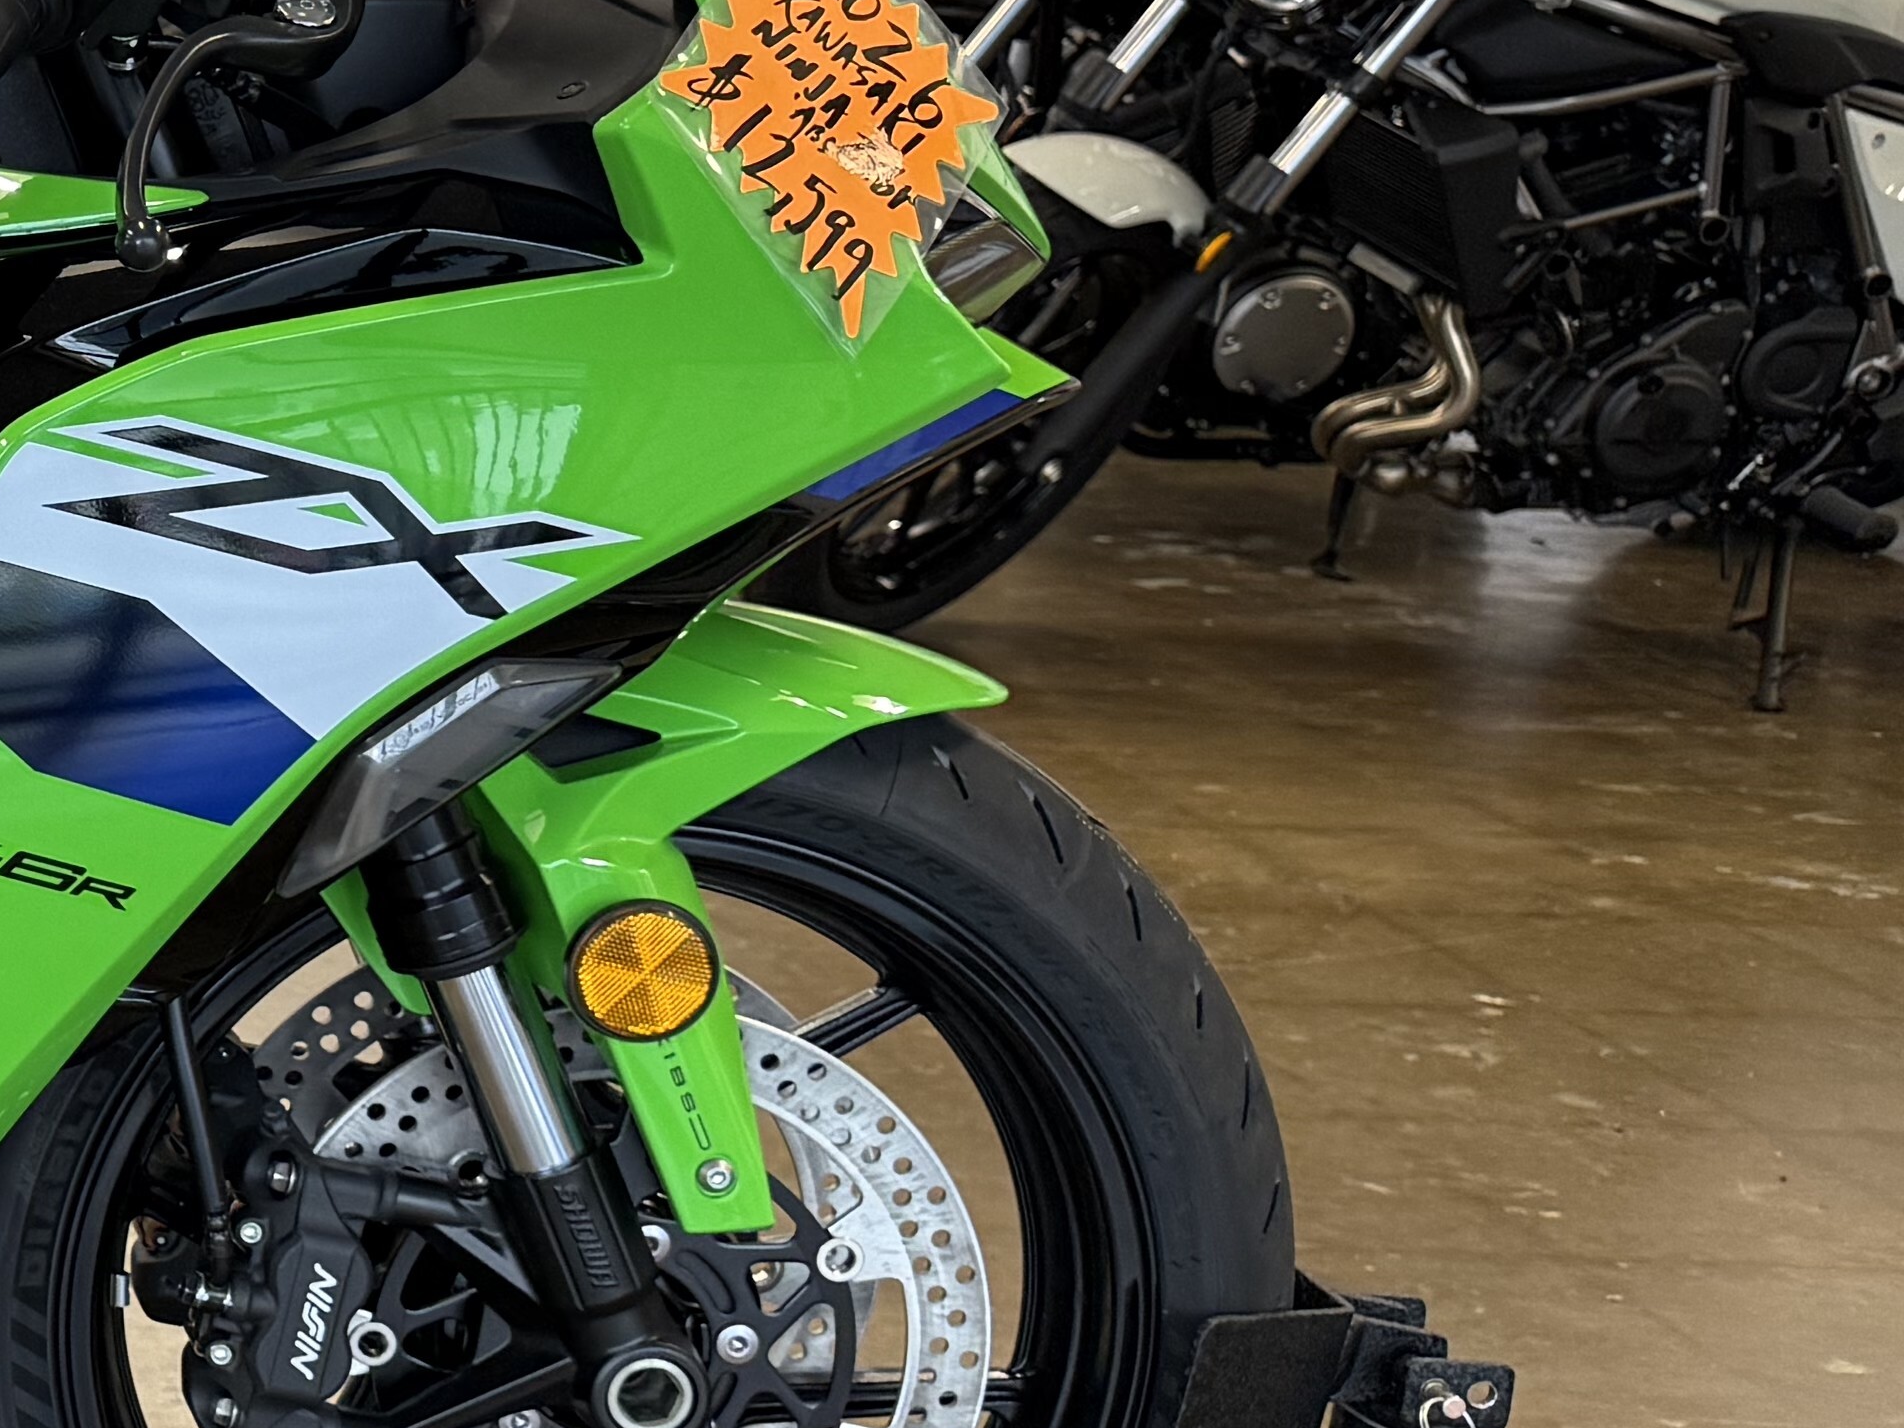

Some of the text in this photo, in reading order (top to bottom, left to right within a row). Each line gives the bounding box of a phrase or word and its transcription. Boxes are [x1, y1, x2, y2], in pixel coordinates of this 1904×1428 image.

[751, 19, 851, 127] NINJA
[687, 53, 875, 301] $12,599
[42, 423, 595, 622] ZX
[290, 1262, 341, 1382] NISSIN
